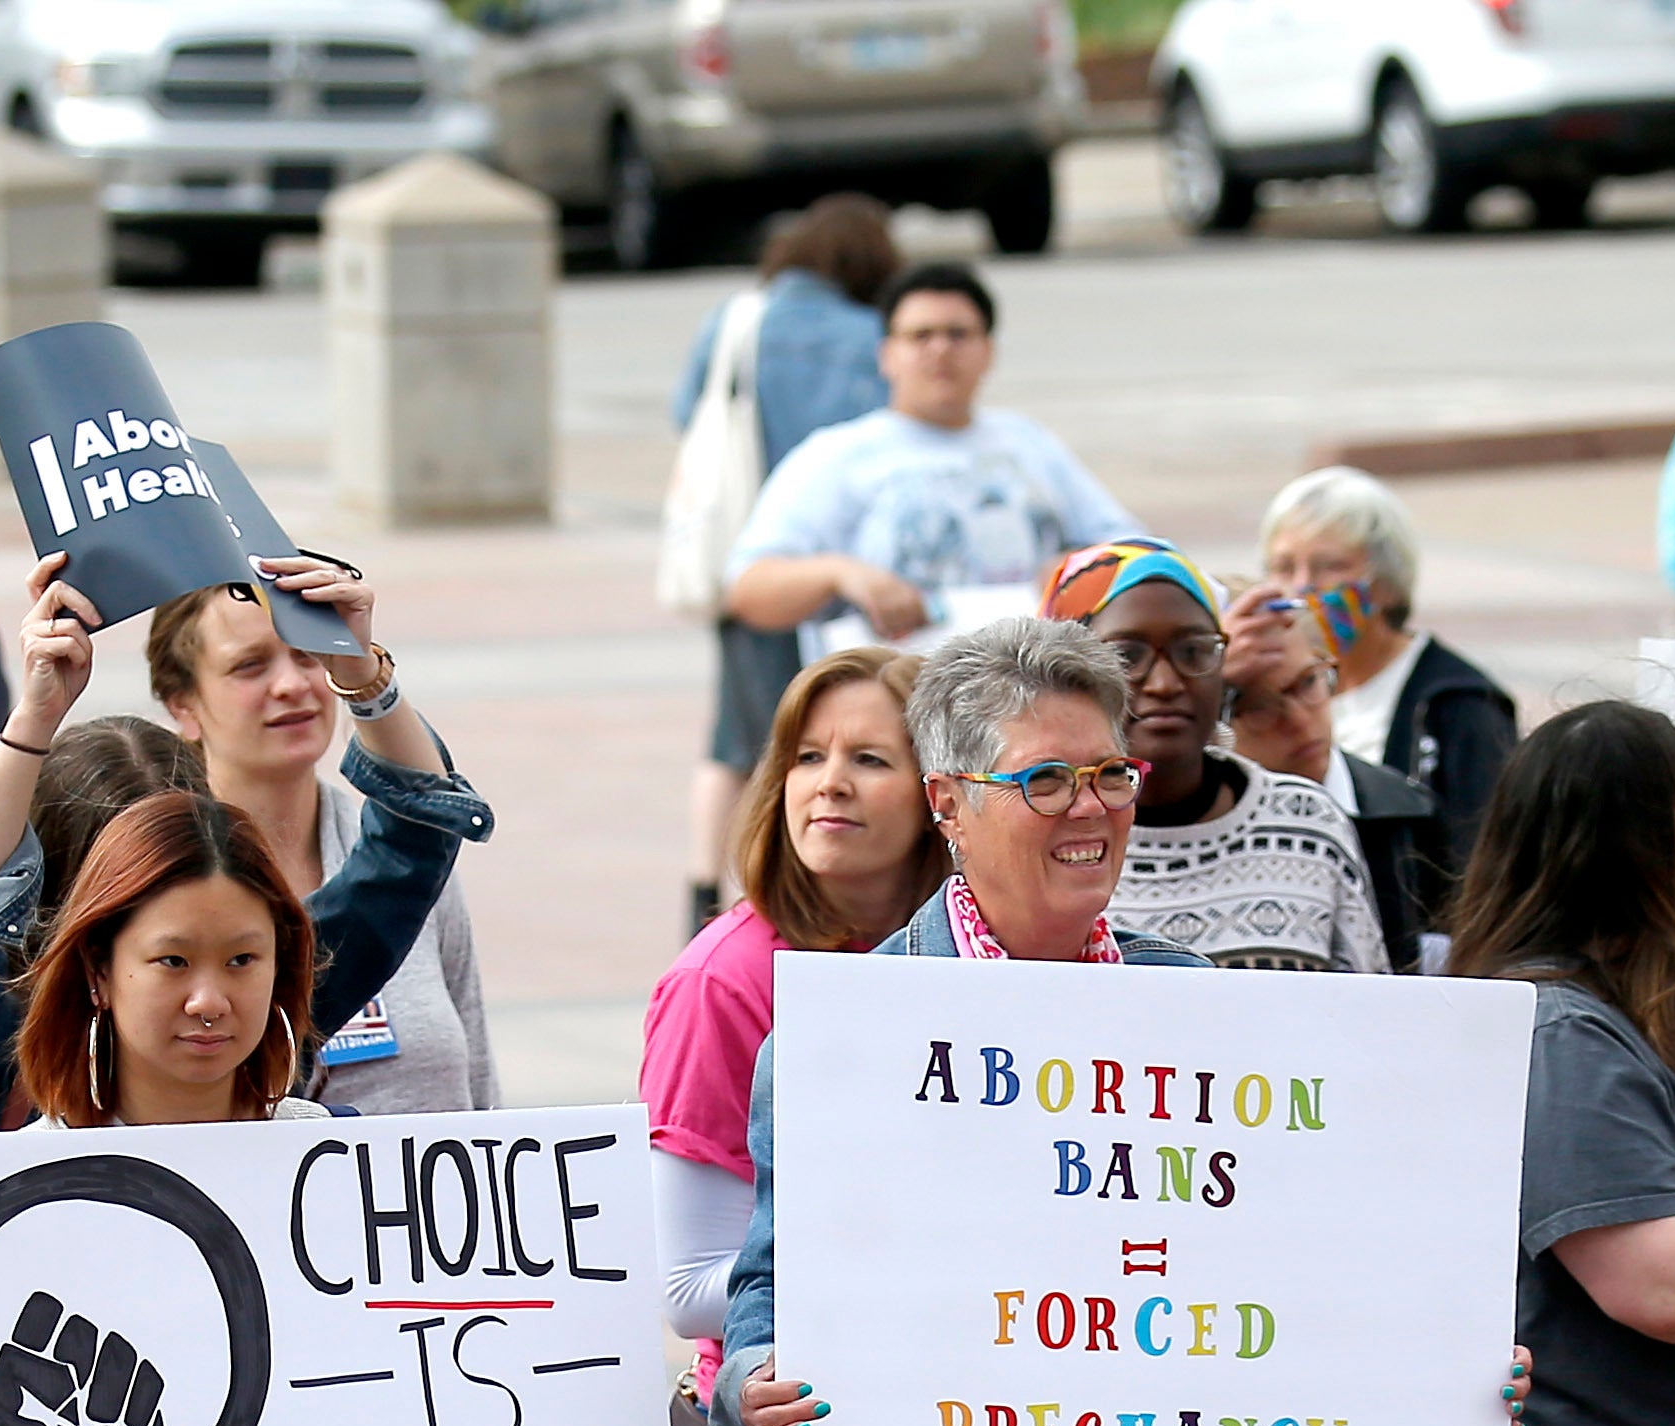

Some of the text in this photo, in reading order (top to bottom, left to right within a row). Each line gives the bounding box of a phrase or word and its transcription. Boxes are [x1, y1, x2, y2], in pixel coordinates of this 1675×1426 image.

[915, 1040, 1325, 1131] ABORTION
[1053, 1140, 1237, 1208] BANS
[290, 1134, 627, 1295] CHOICE
[993, 1290, 1275, 1359] FORCED
